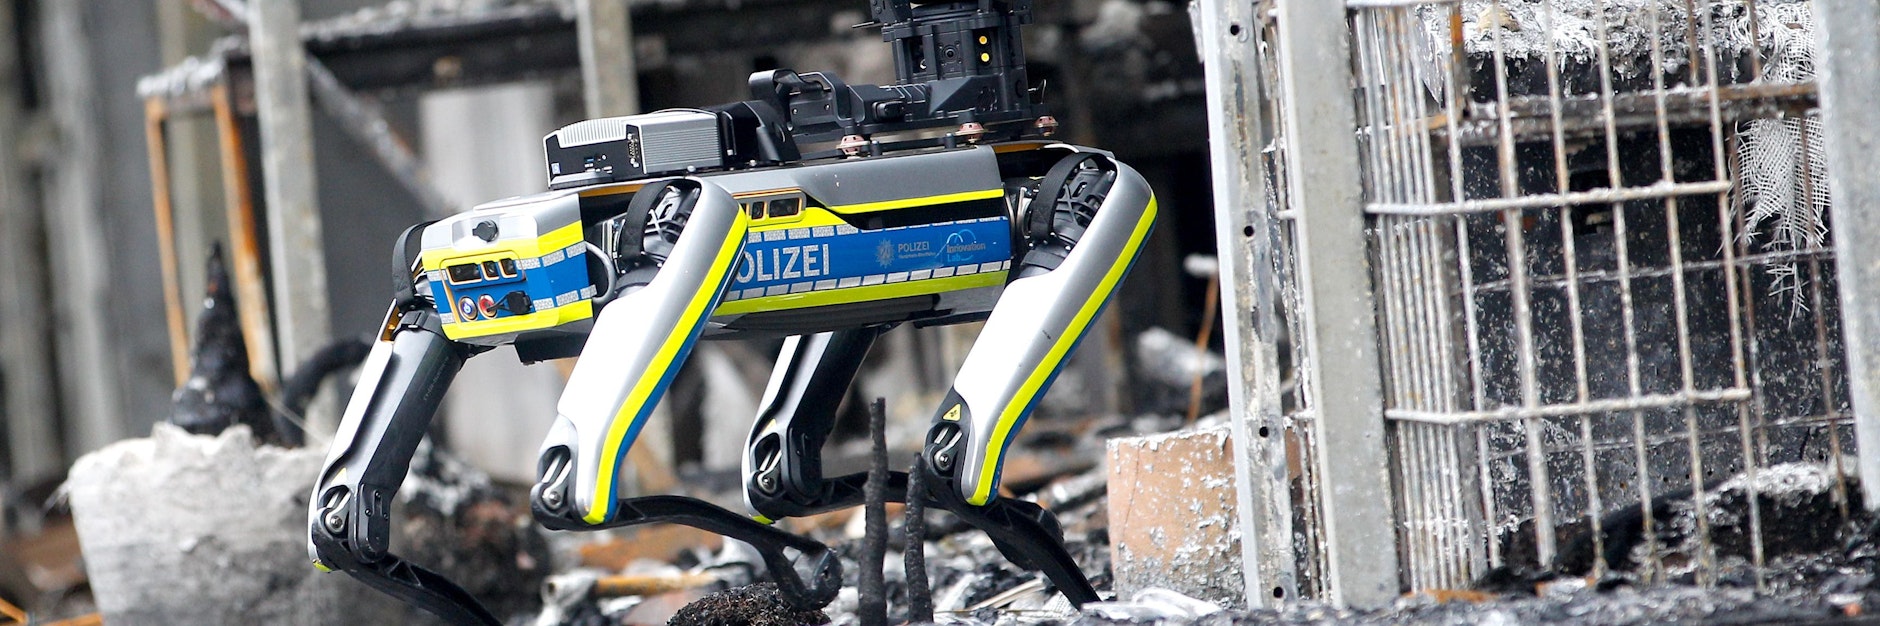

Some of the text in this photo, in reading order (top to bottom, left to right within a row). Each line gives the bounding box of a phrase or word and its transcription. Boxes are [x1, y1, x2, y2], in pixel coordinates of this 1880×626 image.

[897, 241, 930, 253] POLIZEI
[946, 242, 986, 253] Innovation
[736, 243, 829, 283] OLIZEI
[947, 254, 962, 262] Lab
